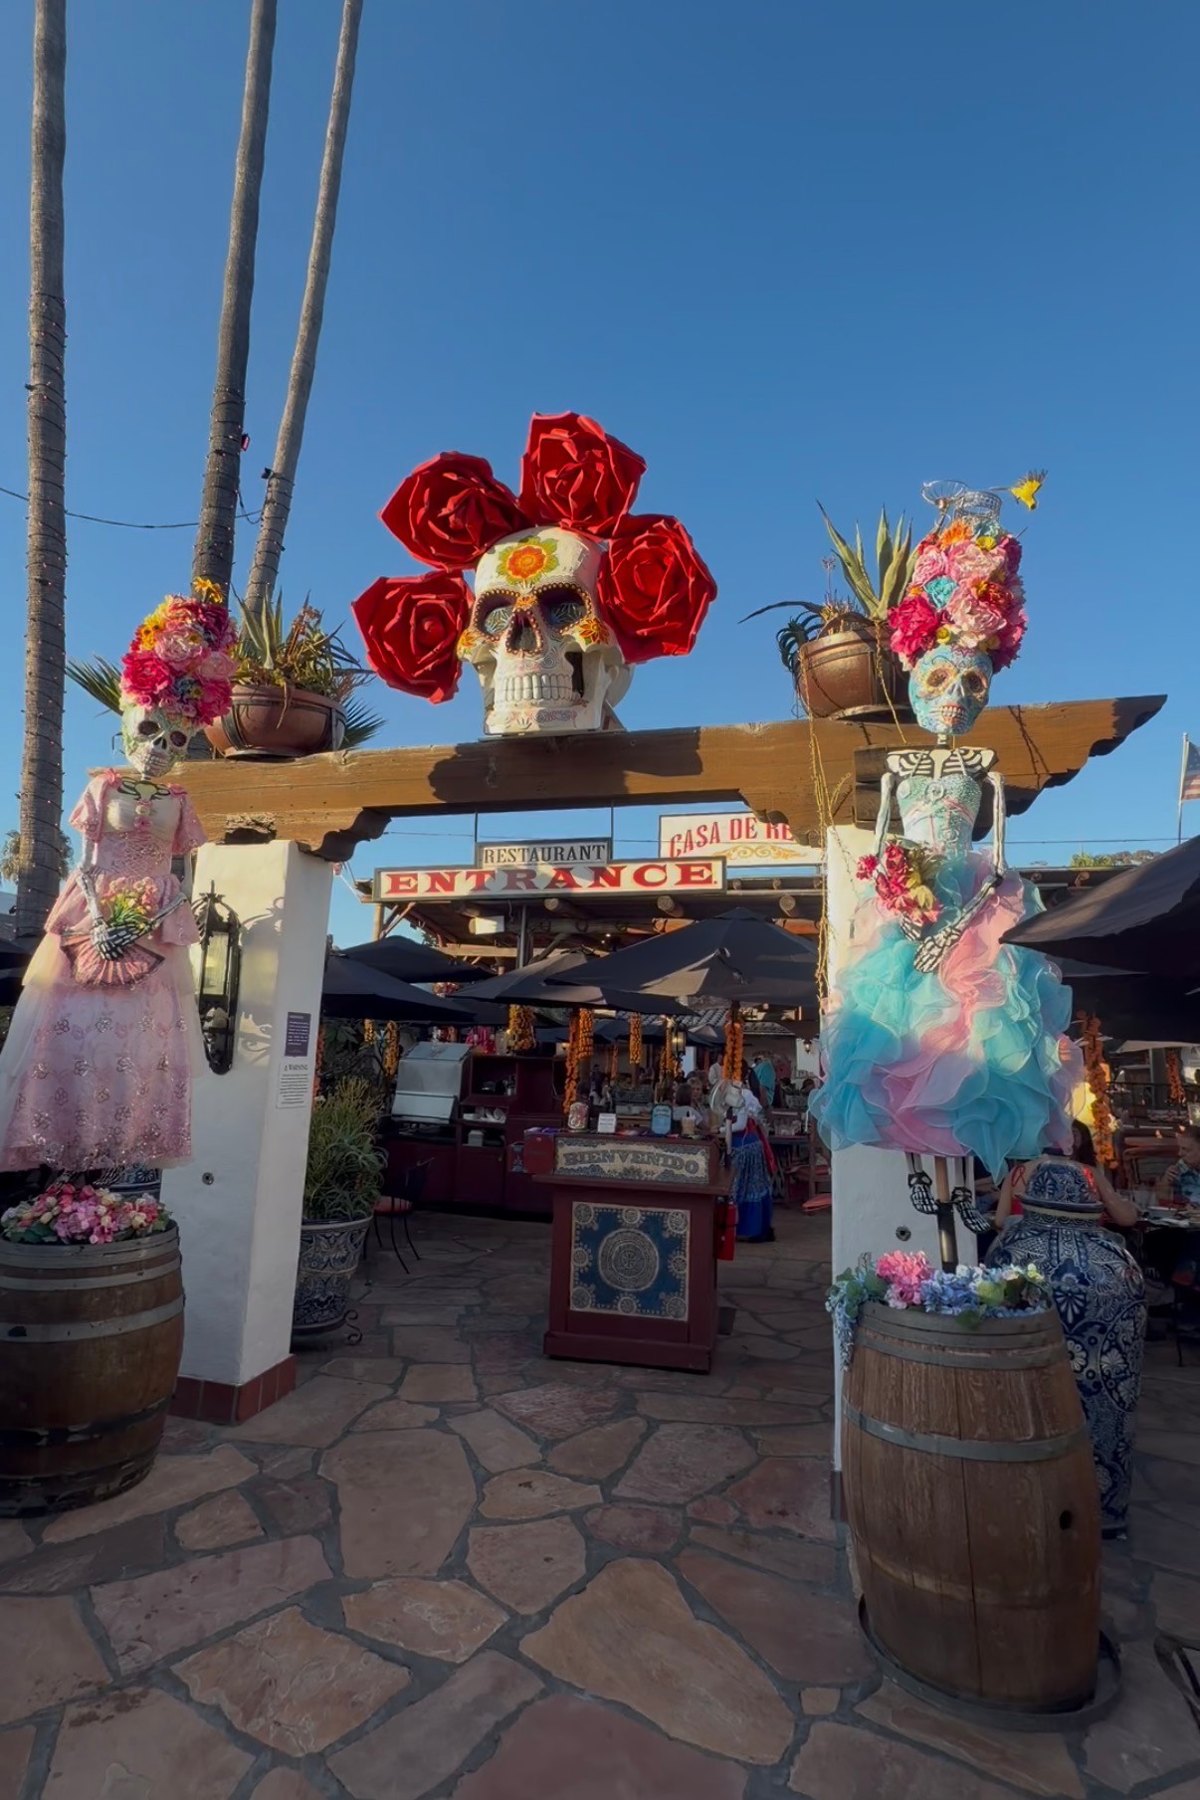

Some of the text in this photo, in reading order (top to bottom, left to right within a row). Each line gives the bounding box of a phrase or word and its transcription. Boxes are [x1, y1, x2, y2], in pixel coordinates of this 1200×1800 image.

[669, 821, 721, 858] CASA
[730, 817, 758, 841] DE
[484, 844, 606, 864] RESTAURANT
[563, 1150, 700, 1174] BIENVENIDO
